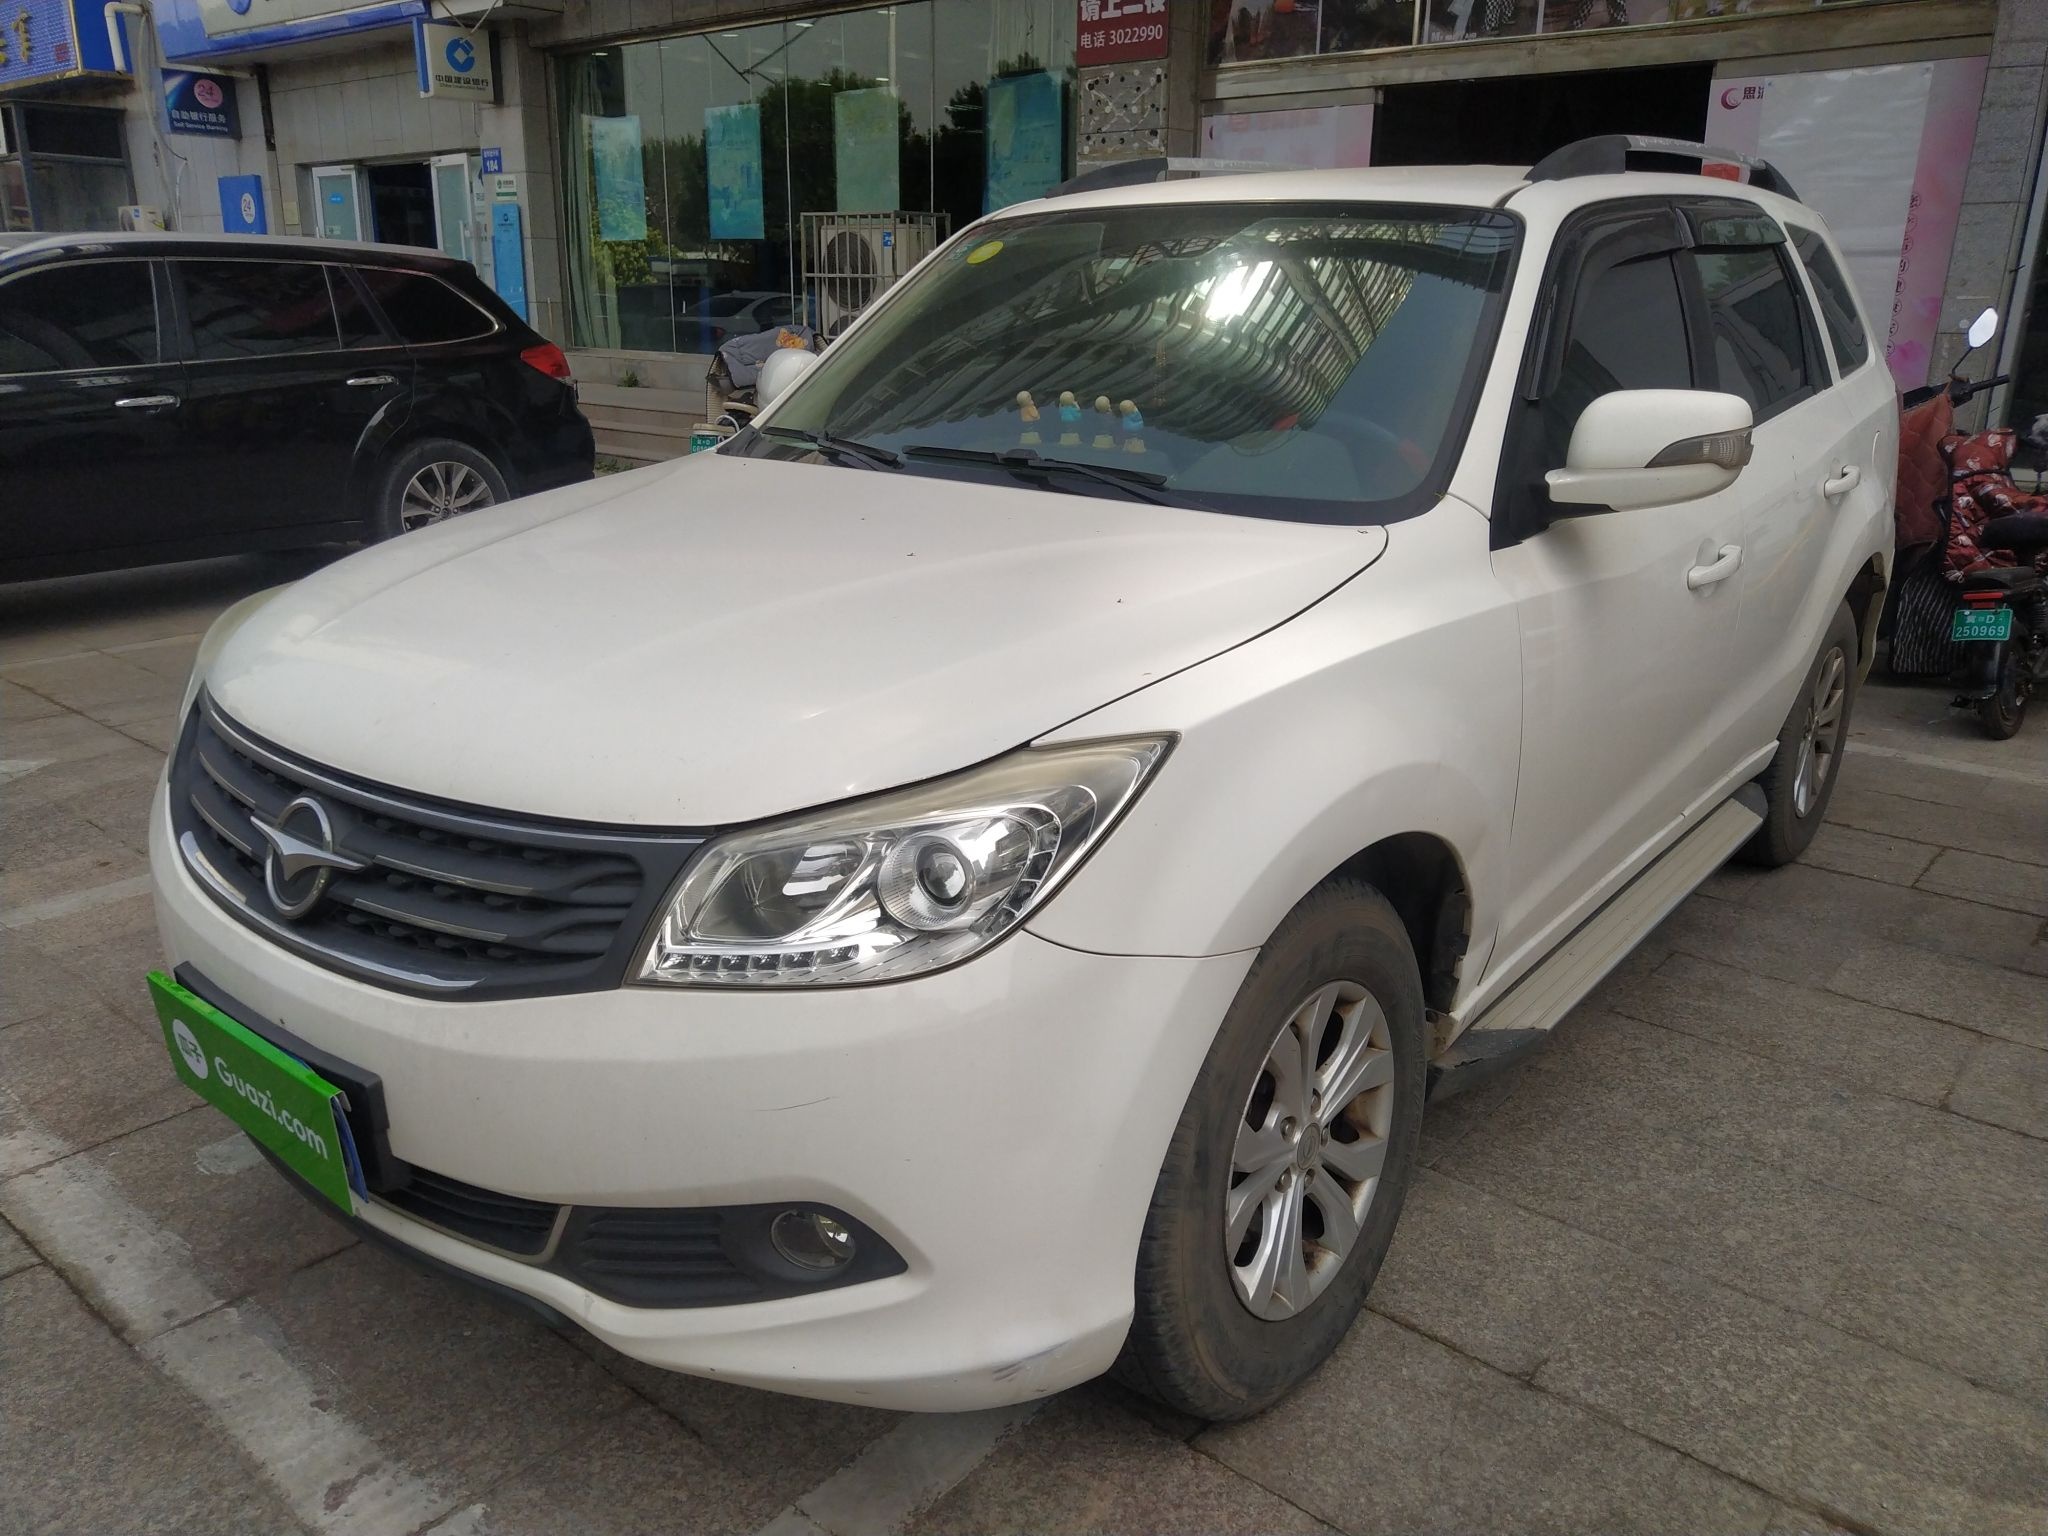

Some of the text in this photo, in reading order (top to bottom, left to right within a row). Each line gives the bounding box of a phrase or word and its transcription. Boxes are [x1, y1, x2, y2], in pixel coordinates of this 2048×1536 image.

[1080, 24, 1163, 49] 电话 3022990
[435, 74, 489, 87] 中国建设银行
[198, 83, 214, 97] 24
[171, 109, 227, 124] 自助银行服务
[1955, 625, 2005, 638] 250969
[214, 1056, 329, 1160] Guazi.com
